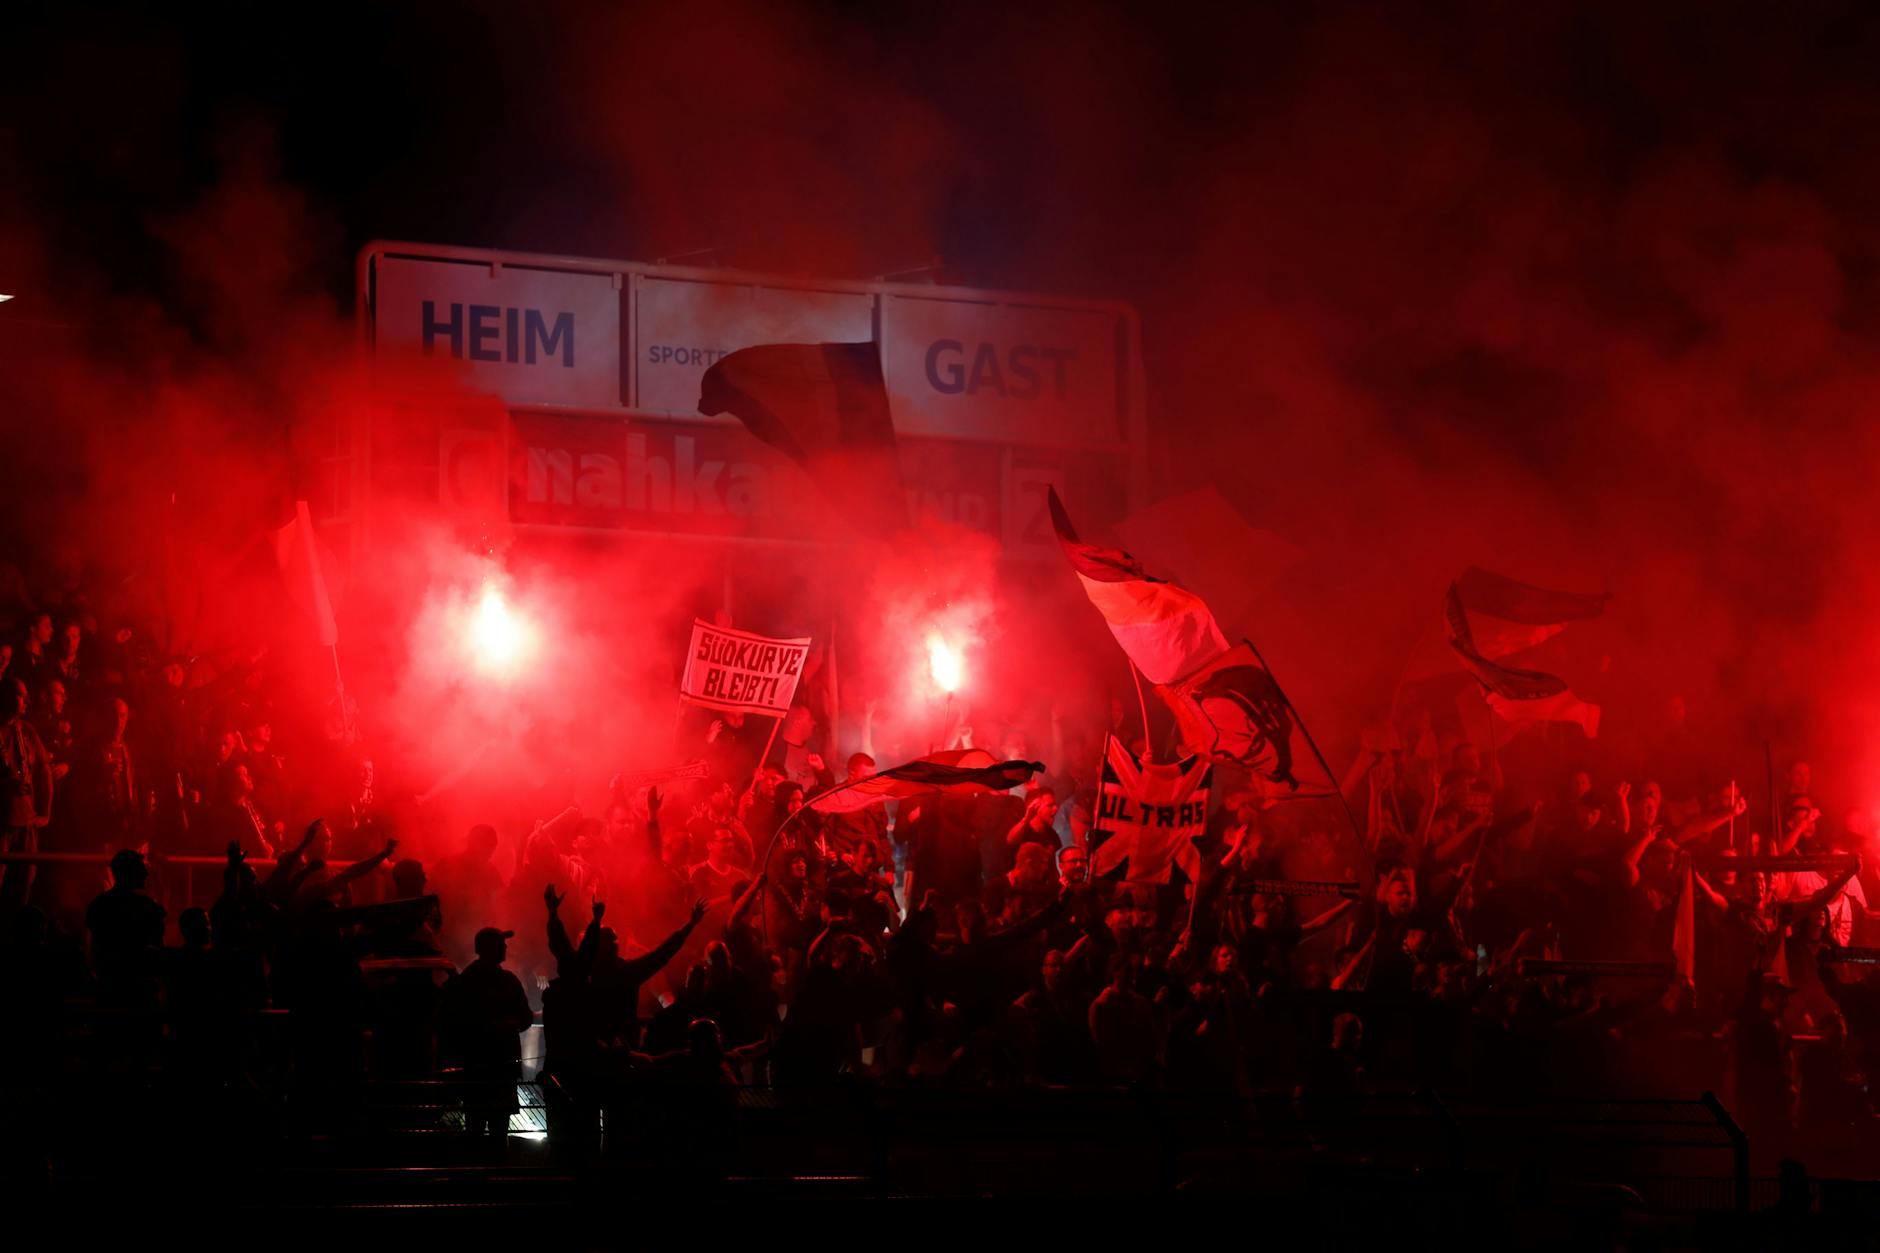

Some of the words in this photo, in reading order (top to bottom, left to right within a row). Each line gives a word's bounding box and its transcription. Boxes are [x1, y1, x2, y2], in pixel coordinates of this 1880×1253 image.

[422, 299, 575, 368] HEIM
[925, 339, 1079, 400] GAST
[697, 632, 802, 676] SÜDKURVE
[703, 668, 779, 705] BLEIBT!
[1100, 793, 1204, 828] ULTRAS
